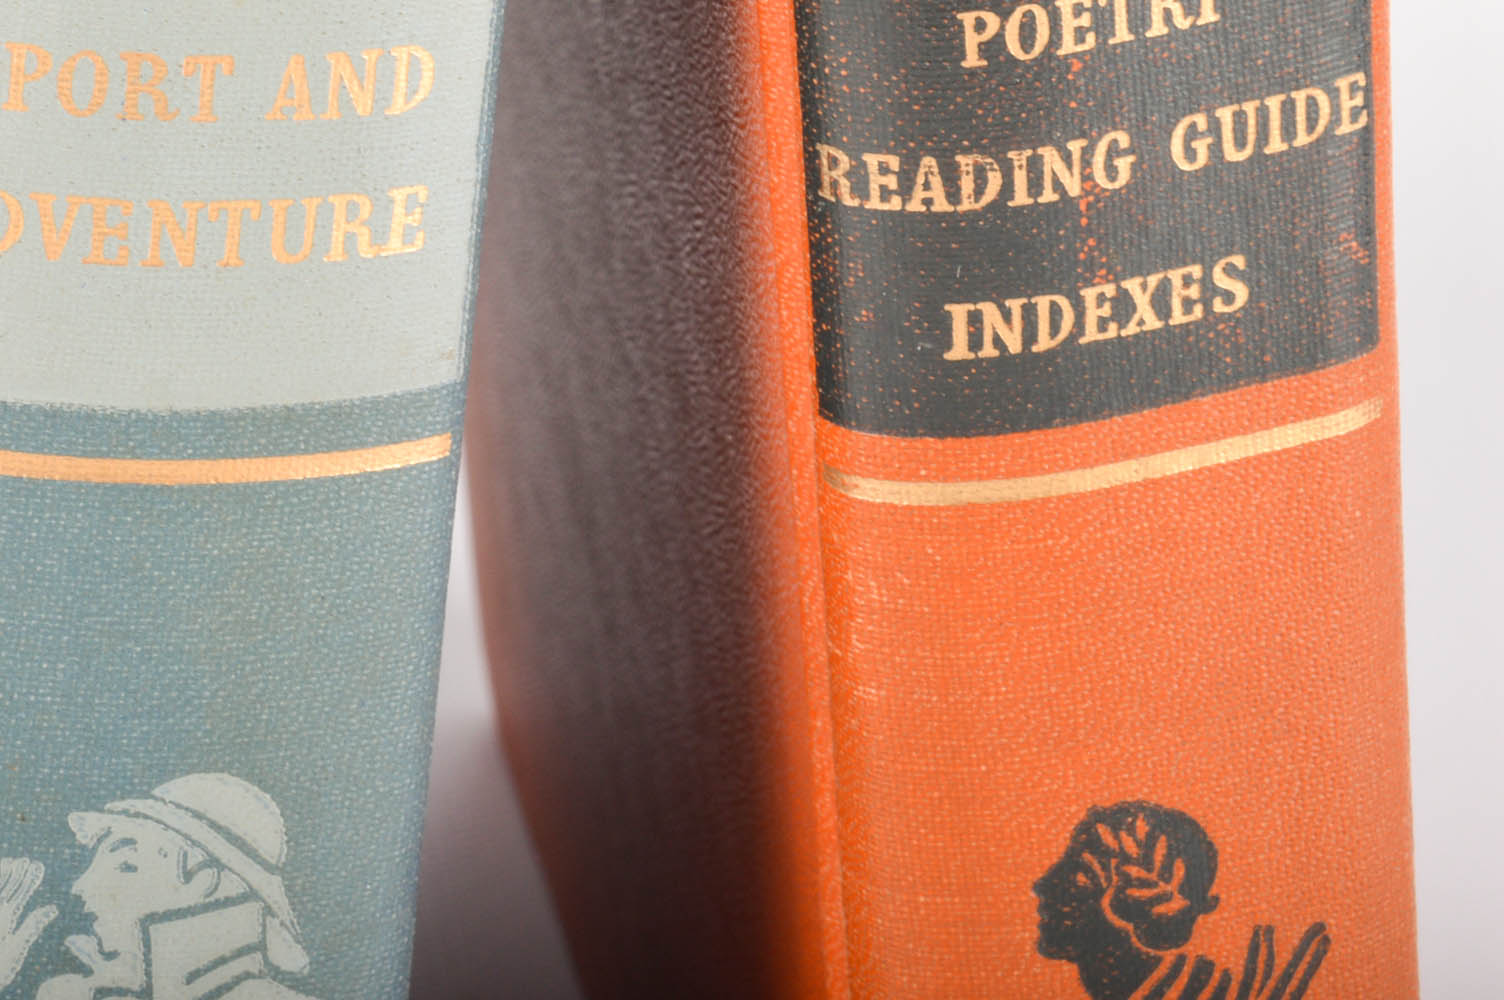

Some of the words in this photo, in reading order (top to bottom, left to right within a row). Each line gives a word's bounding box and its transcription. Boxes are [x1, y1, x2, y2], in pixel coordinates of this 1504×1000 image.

[264, 43, 436, 121] AND
[814, 129, 1138, 214] READING
[1168, 71, 1370, 173] GUIDE
[942, 254, 1251, 362] INDEXES
